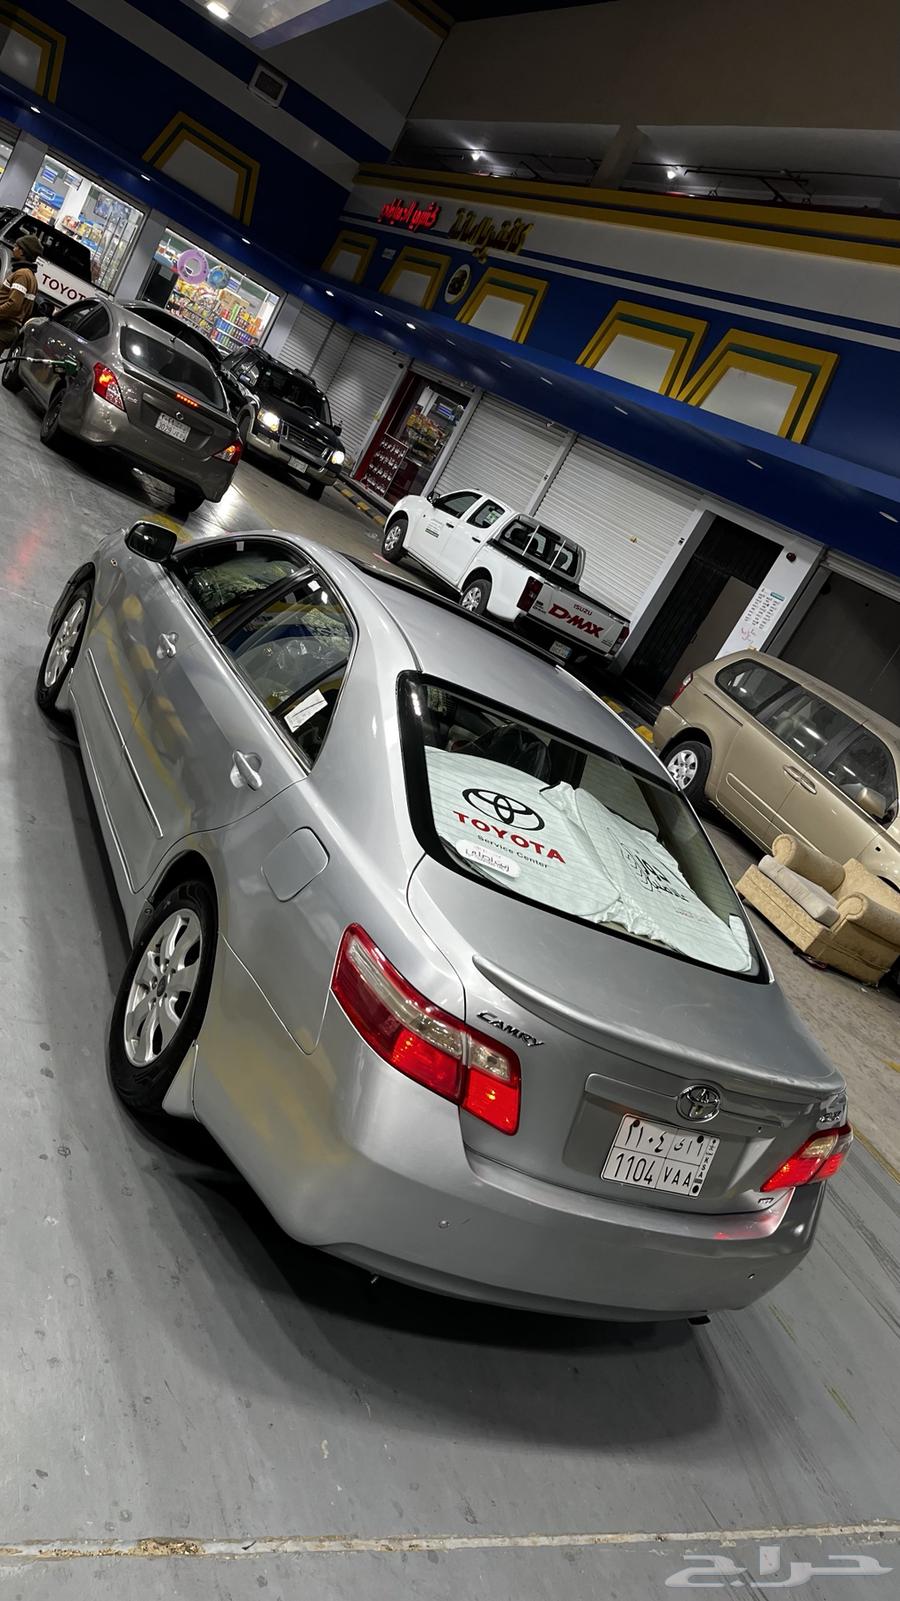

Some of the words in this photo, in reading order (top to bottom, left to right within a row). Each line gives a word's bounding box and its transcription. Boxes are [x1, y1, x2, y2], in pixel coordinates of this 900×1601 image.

[42, 273, 87, 300] TOYOT
[574, 603, 594, 617] ISUZU
[452, 811, 566, 865] TOYOTA
[477, 835, 515, 851] Service
[516, 850, 550, 869] Center
[476, 1010, 545, 1048] CAMRY
[615, 1152, 657, 1185] 1104
[664, 1165, 693, 1188] VAA
